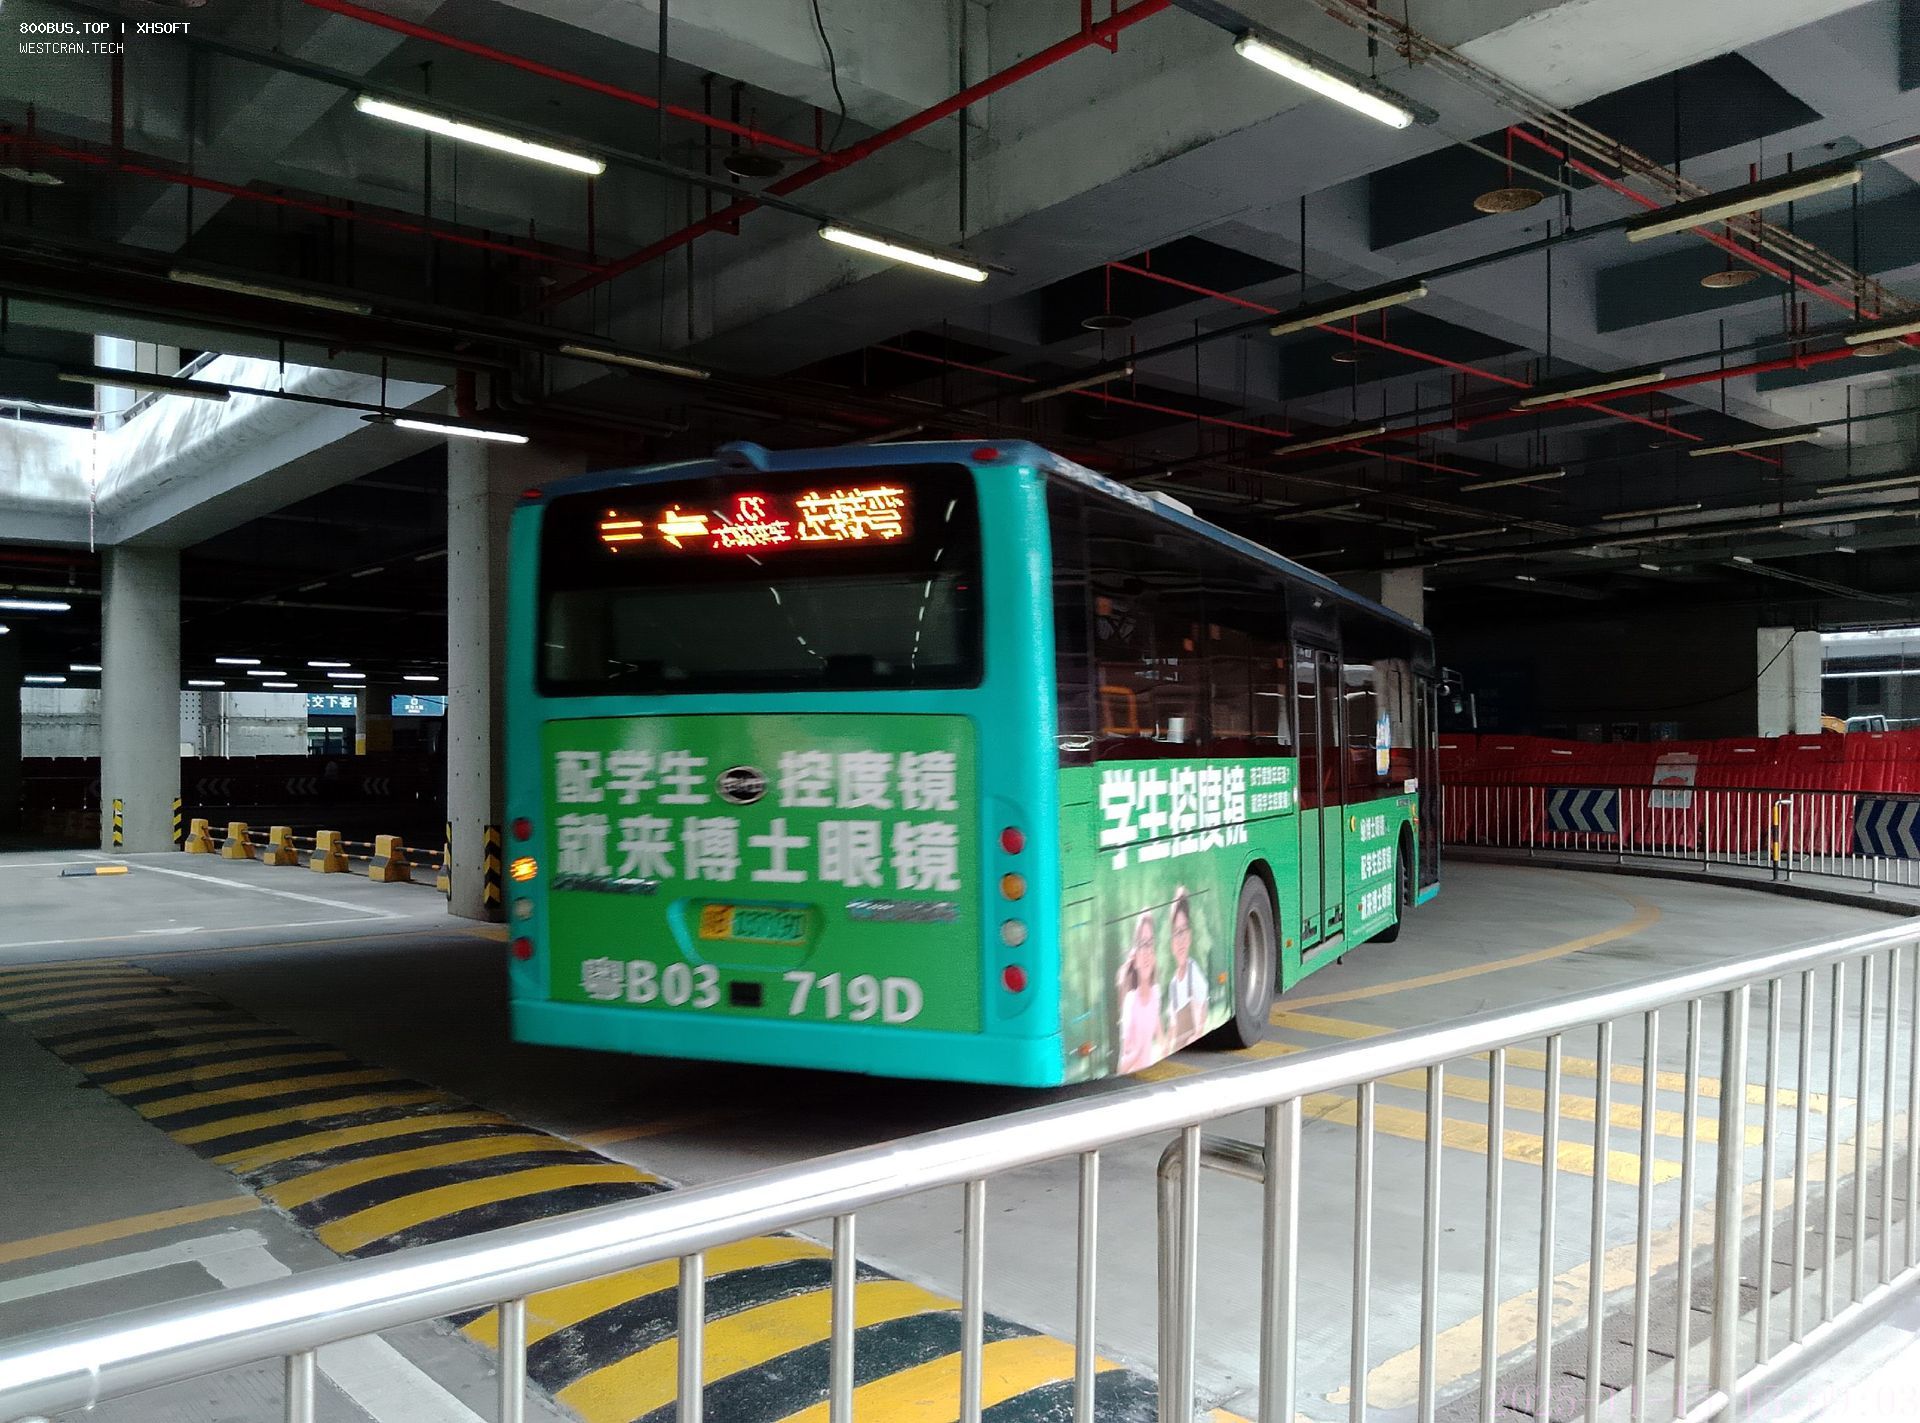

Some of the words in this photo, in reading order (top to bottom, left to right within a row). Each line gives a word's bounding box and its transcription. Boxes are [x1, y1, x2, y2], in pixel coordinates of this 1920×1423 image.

[306, 695, 358, 709] 交下客
[554, 749, 711, 805] 配学生
[778, 750, 959, 812] 控度镜
[1099, 765, 1248, 871] 学生控度镜
[554, 812, 961, 892] 就来博士眼镜
[580, 957, 721, 1009] 粤B03
[783, 971, 925, 1024] 719D
